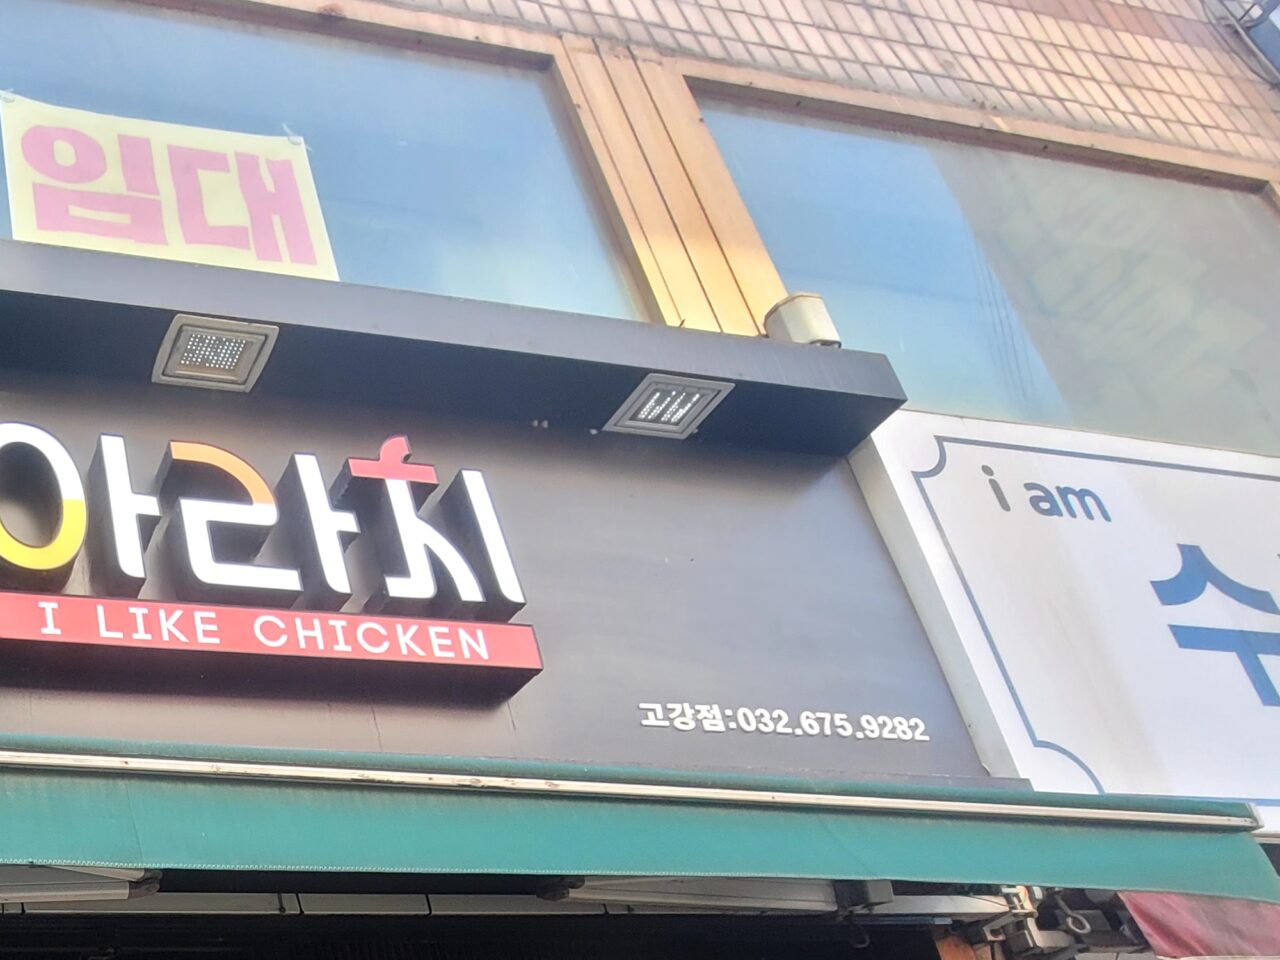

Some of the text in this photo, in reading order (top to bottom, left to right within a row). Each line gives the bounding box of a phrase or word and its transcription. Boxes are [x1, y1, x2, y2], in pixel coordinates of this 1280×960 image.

[21, 125, 318, 266] 임대
[982, 465, 1111, 523] i am
[37, 601, 489, 661] I LIKE CHICKEN
